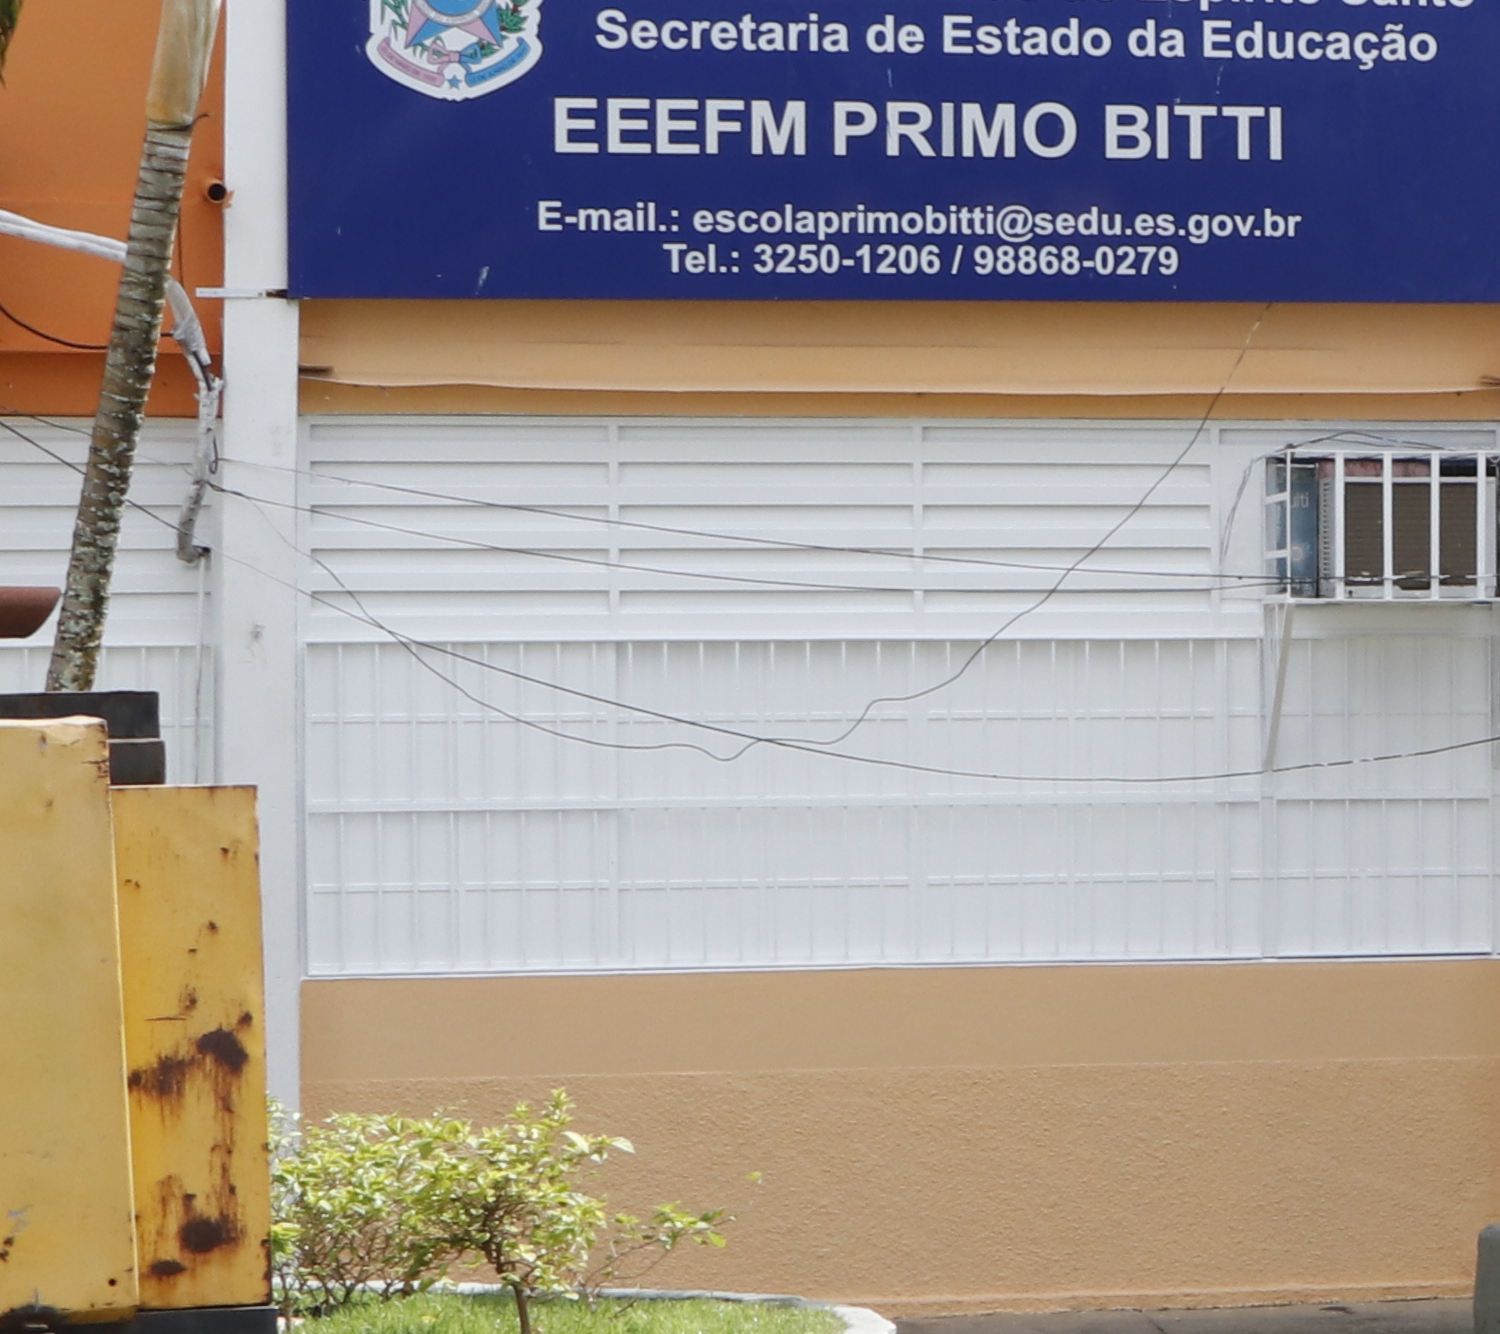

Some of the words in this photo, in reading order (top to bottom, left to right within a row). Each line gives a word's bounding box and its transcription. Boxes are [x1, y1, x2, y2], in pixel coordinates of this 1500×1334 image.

[595, 9, 850, 53] Secretaria
[865, 14, 925, 54] de
[942, 14, 1112, 57] Estado
[1127, 18, 1186, 58] da
[1202, 19, 1438, 70] Educação
[554, 97, 806, 156] EEEFM
[833, 101, 1077, 158] PRIMO
[1105, 104, 1283, 161] BITTI
[538, 200, 679, 232] E-mail.:
[693, 203, 1302, 244] escolaprimobitti@sedu.es.gov.br
[662, 243, 740, 274] Tel.:
[753, 243, 941, 275] 3250-1206
[951, 244, 964, 275] /
[973, 245, 1179, 276] 98868-0279
